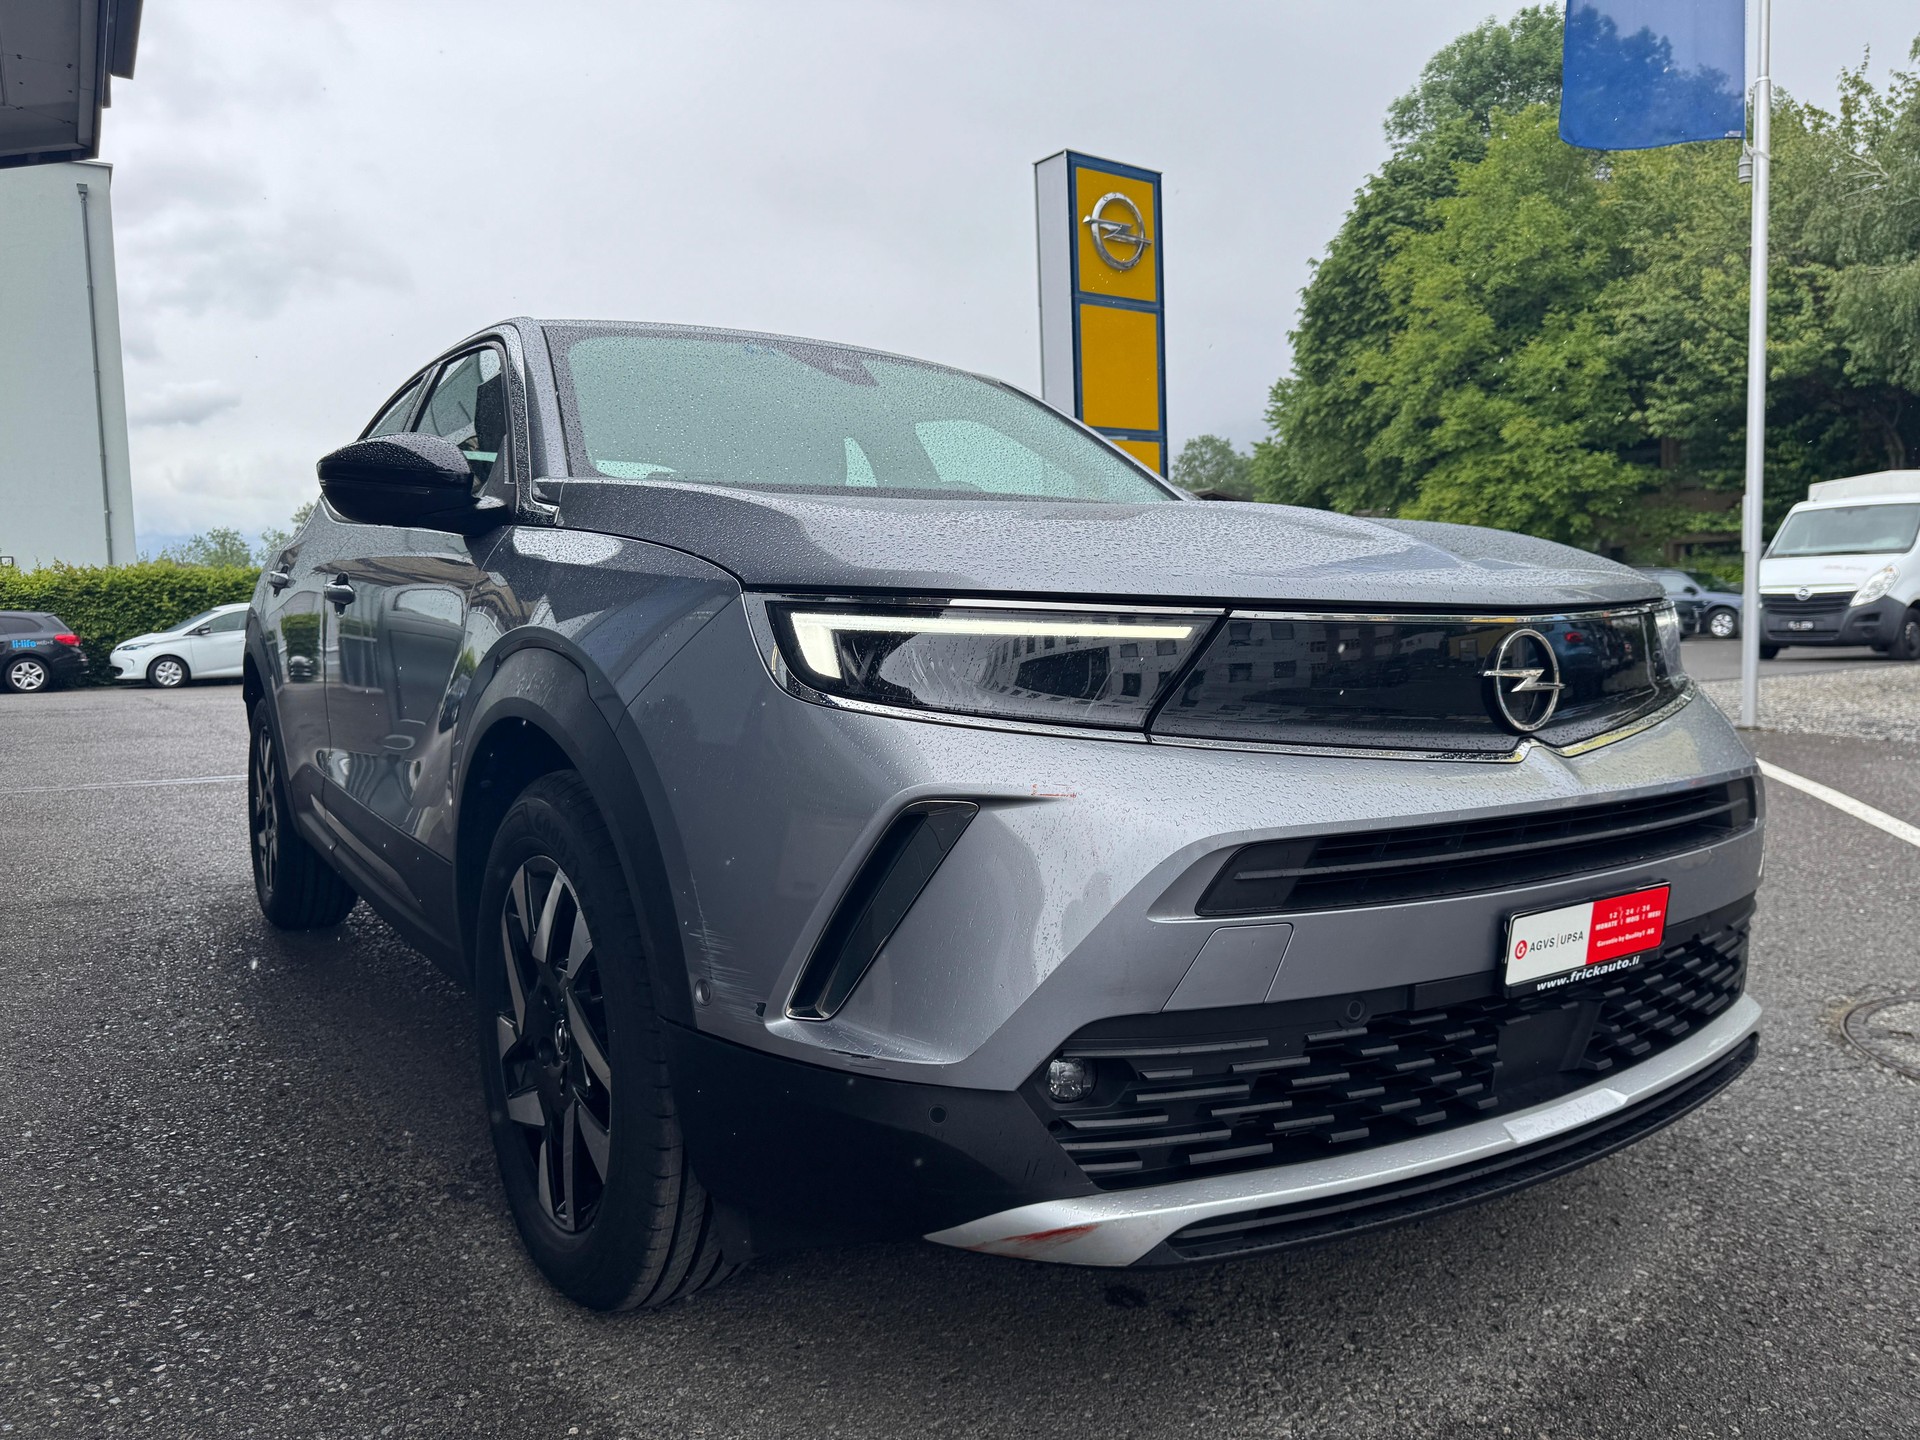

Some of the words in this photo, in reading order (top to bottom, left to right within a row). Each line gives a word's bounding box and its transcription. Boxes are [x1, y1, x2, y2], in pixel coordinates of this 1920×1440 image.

[1609, 911, 1618, 920] 12
[1529, 937, 1555, 953] AGVS
[1560, 930, 1584, 945] UPSA
[1536, 954, 1641, 991] www.frickauto.li
